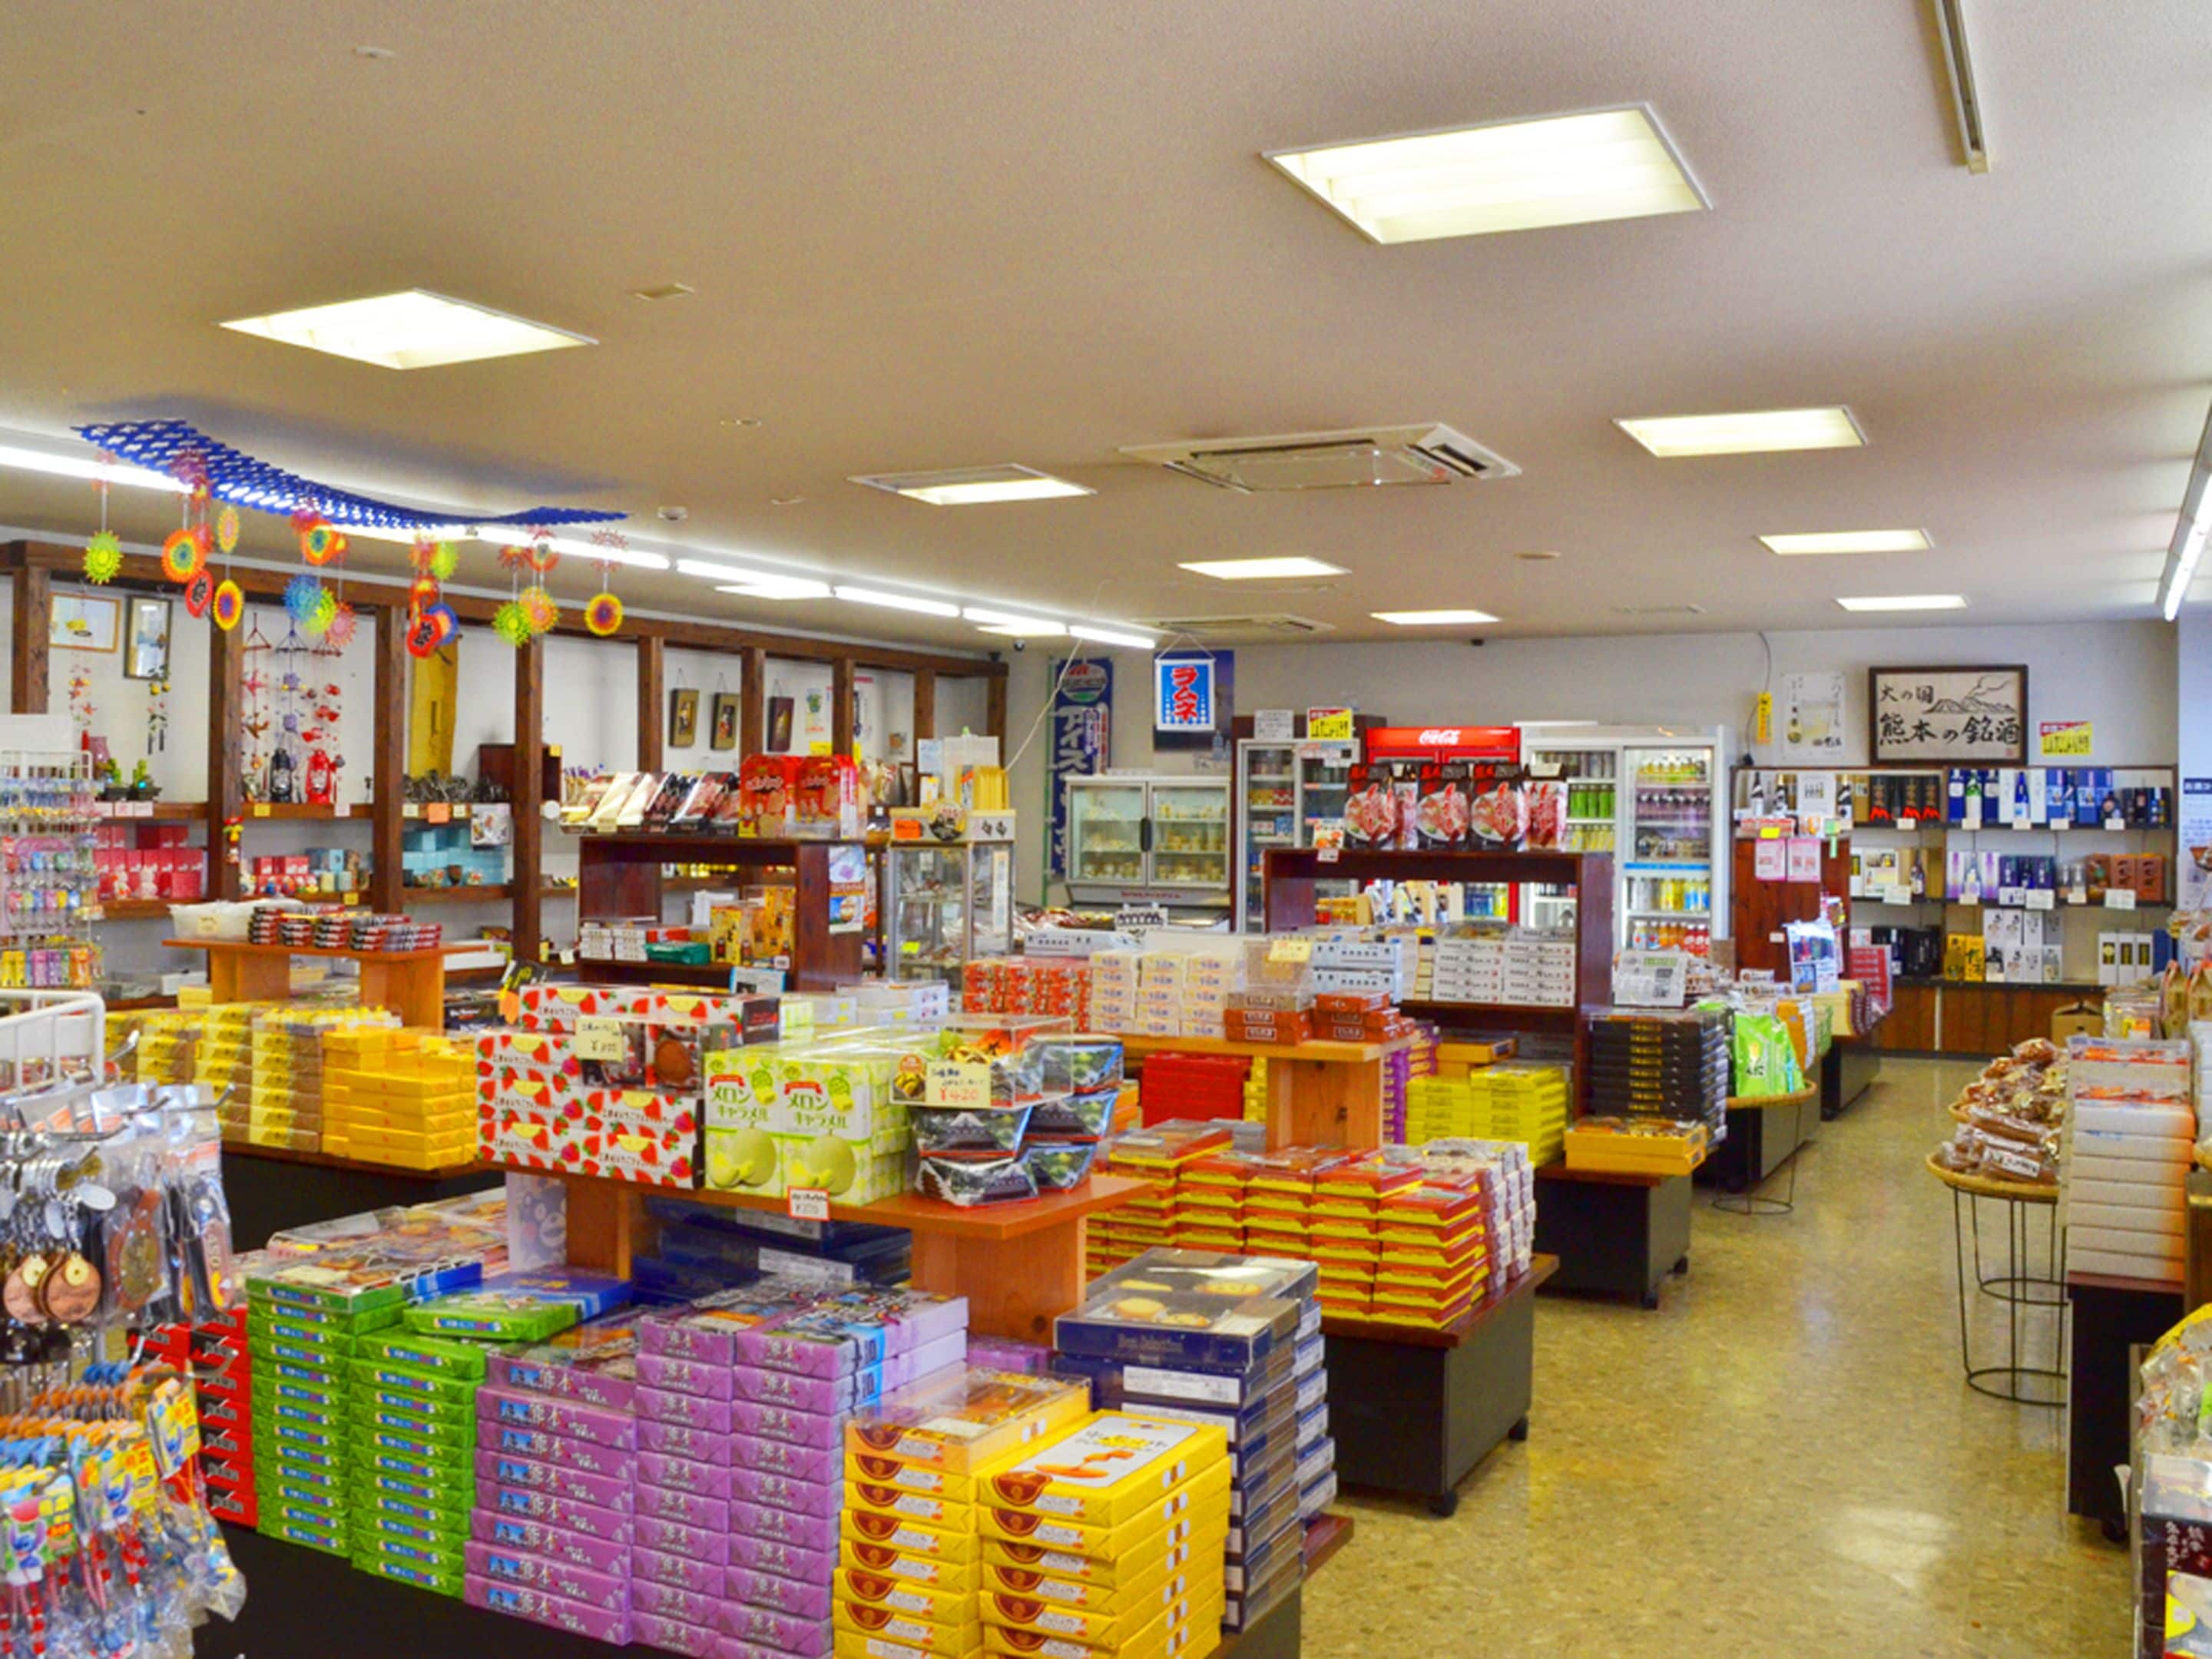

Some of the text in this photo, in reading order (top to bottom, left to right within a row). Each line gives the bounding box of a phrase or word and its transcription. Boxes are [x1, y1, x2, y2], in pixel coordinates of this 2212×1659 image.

[1172, 667, 1198, 721] ラムネ
[1879, 714, 2021, 745] 熊本の銘酒
[712, 1085, 751, 1104] メロン
[786, 1093, 828, 1111] メロン
